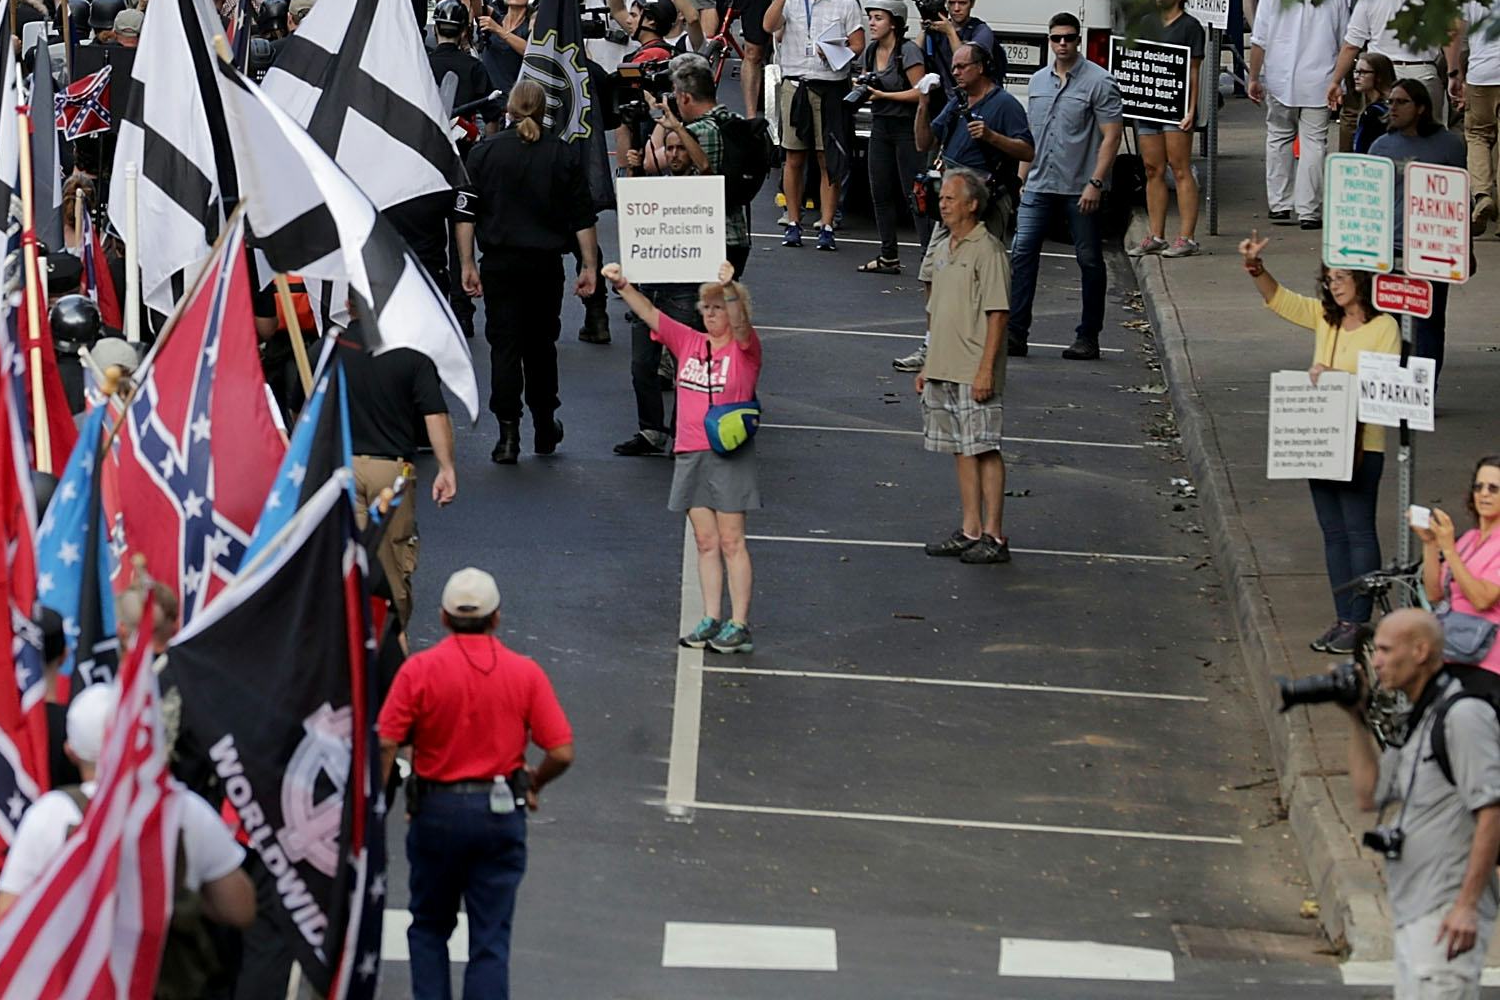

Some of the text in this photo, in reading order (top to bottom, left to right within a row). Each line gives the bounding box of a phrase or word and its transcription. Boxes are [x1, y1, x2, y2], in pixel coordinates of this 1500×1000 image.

[1143, 50, 1174, 63] decided
[1175, 55, 1184, 65] to
[1121, 59, 1176, 76] stick to love...
[1114, 69, 1184, 89] Hate is too great a
[1145, 86, 1153, 96] to
[1426, 174, 1449, 196] NO
[627, 202, 714, 217] STOP pretending
[1411, 196, 1464, 222] PARKING
[634, 222, 715, 238] your Racism is
[1415, 221, 1458, 239] ANYTIME
[630, 243, 702, 259] Patriotism
[1409, 238, 1423, 249] TOW
[1379, 280, 1428, 297] EMERGENCY
[1361, 380, 1430, 407] NO PARKING
[209, 733, 329, 967] WORLDWID
